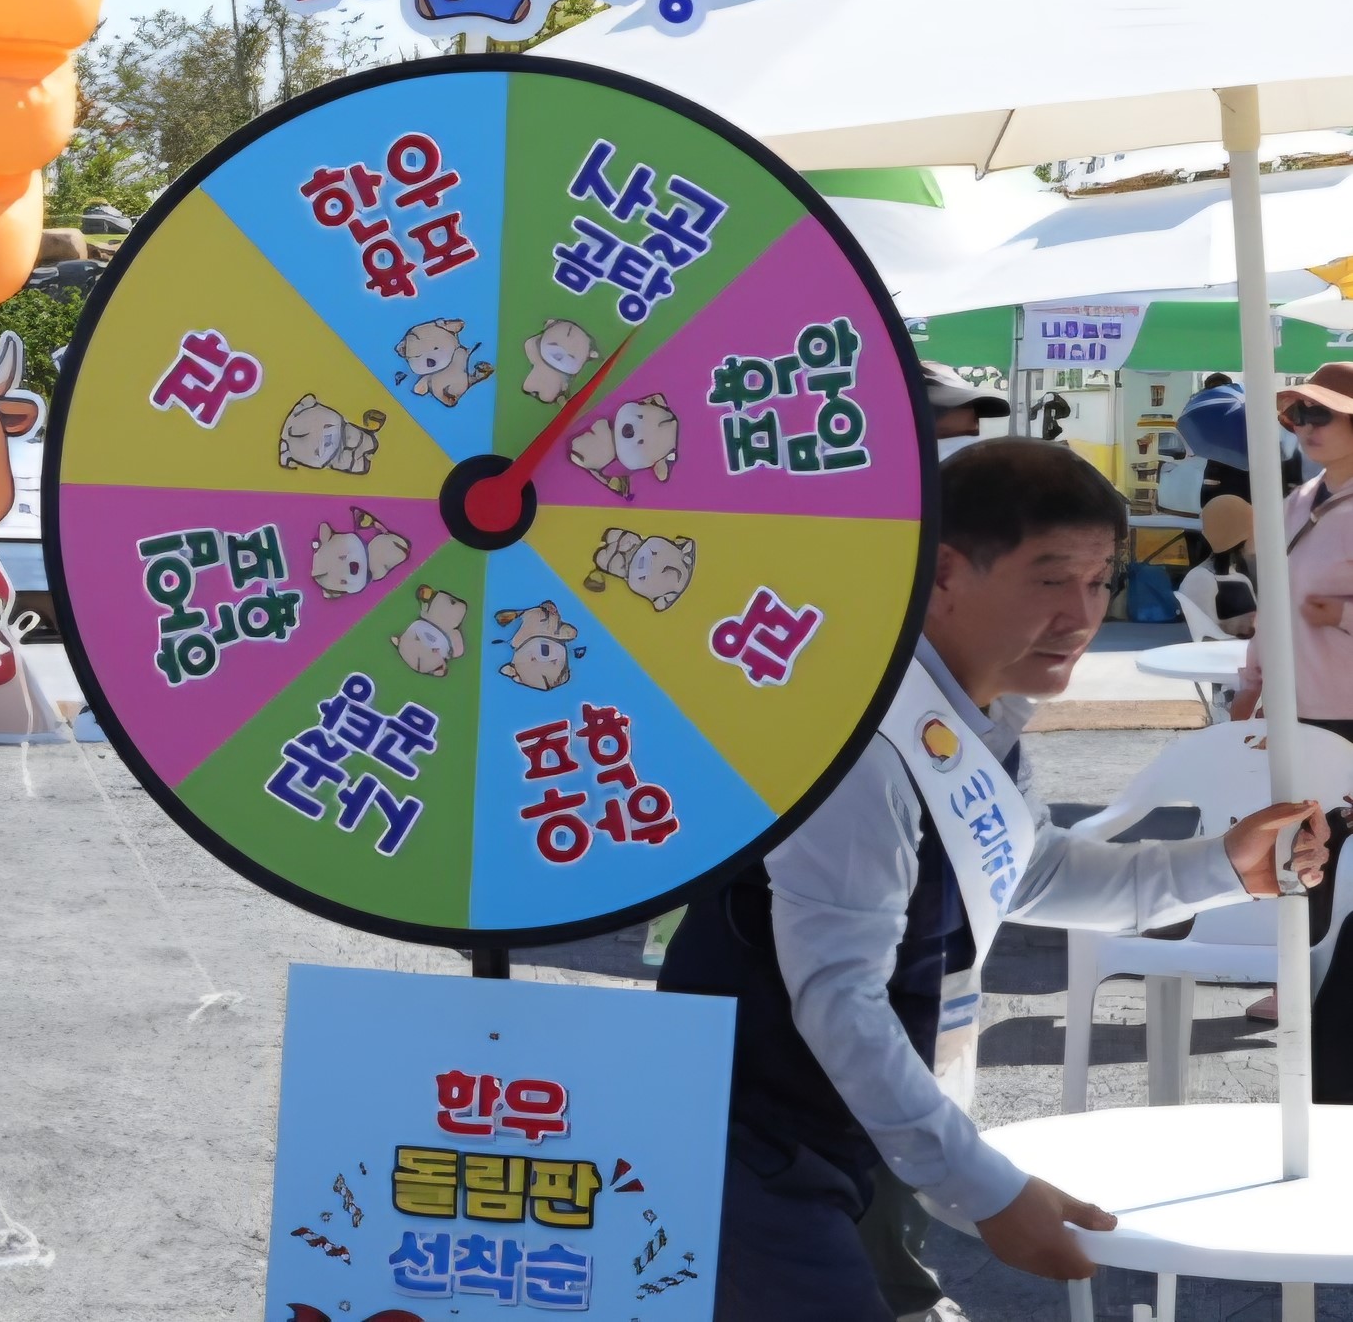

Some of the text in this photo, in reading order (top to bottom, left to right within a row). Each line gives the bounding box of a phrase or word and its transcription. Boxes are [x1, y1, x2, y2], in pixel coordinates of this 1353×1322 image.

[300, 133, 460, 245] 한우
[568, 138, 729, 268] 사골
[553, 216, 675, 325] 곰탕
[773, 316, 871, 475] 한입
[136, 527, 239, 688] 한입
[317, 672, 439, 780] 곰탕
[264, 724, 423, 856] 사골
[520, 762, 680, 863] 한우
[435, 1070, 570, 1144] 한우
[392, 1145, 602, 1229] 돌림판
[389, 1231, 593, 1311] 선착순
